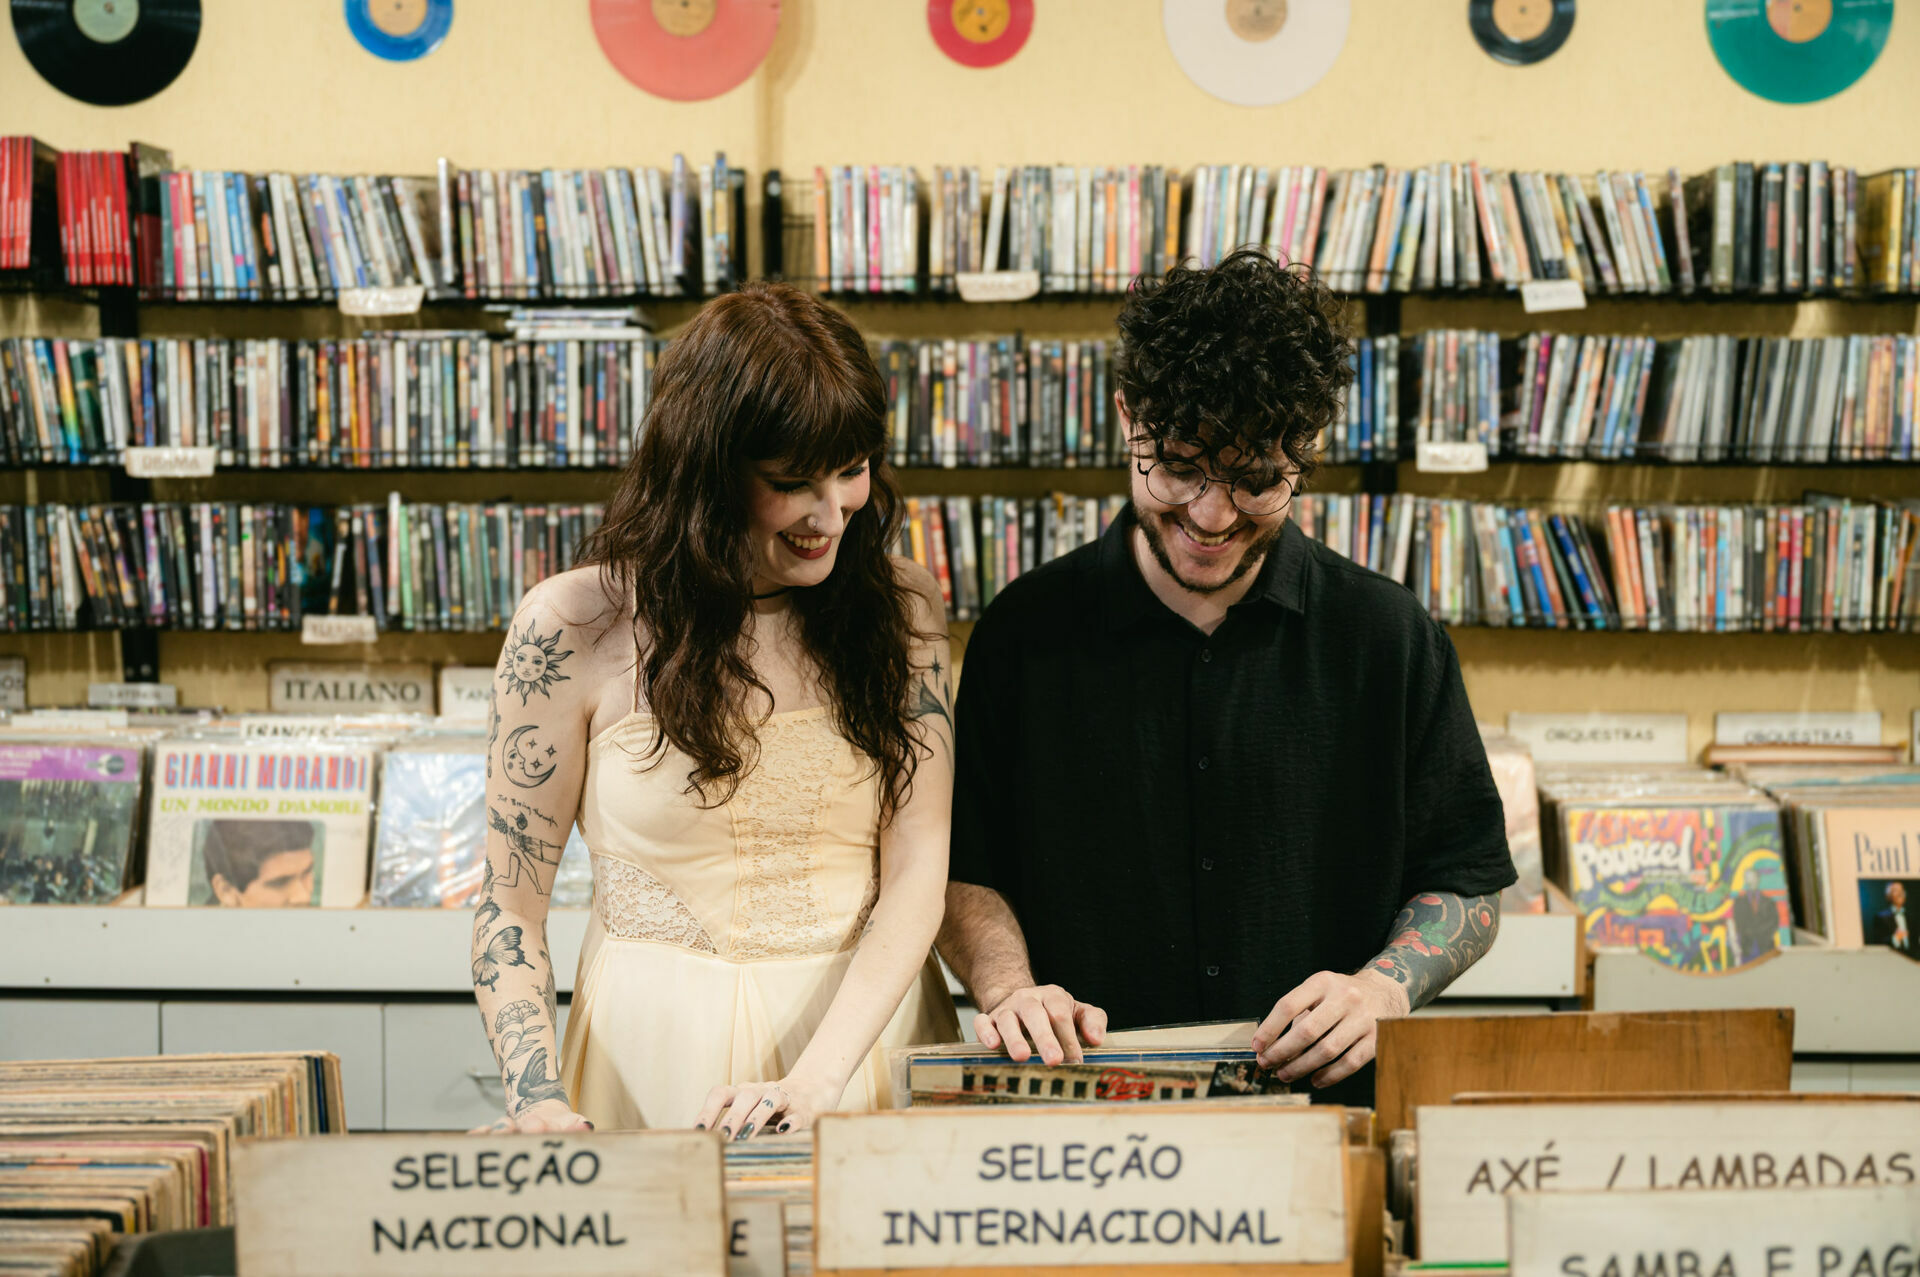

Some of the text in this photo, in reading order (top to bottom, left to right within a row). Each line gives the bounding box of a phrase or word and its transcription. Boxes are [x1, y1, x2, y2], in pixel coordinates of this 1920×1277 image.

[283, 678, 422, 702] ITALIANO
[1545, 727, 1654, 743] ORQUESTRAS
[164, 753, 367, 790] GIANNI MORANDI
[160, 798, 362, 815] UN MONDO D'AMORE
[1853, 831, 1909, 873] Paul
[391, 1140, 601, 1195] SELEÇÃO
[978, 1134, 1182, 1189] SELEÇÃO
[1467, 1140, 1915, 1194] AXÉ / LAMBADAS
[372, 1211, 627, 1254] NACIONAL
[883, 1209, 1281, 1246] INTERNACIONAL
[1560, 1248, 1737, 1277] SAMBA
[1818, 1243, 1920, 1277] PAG
